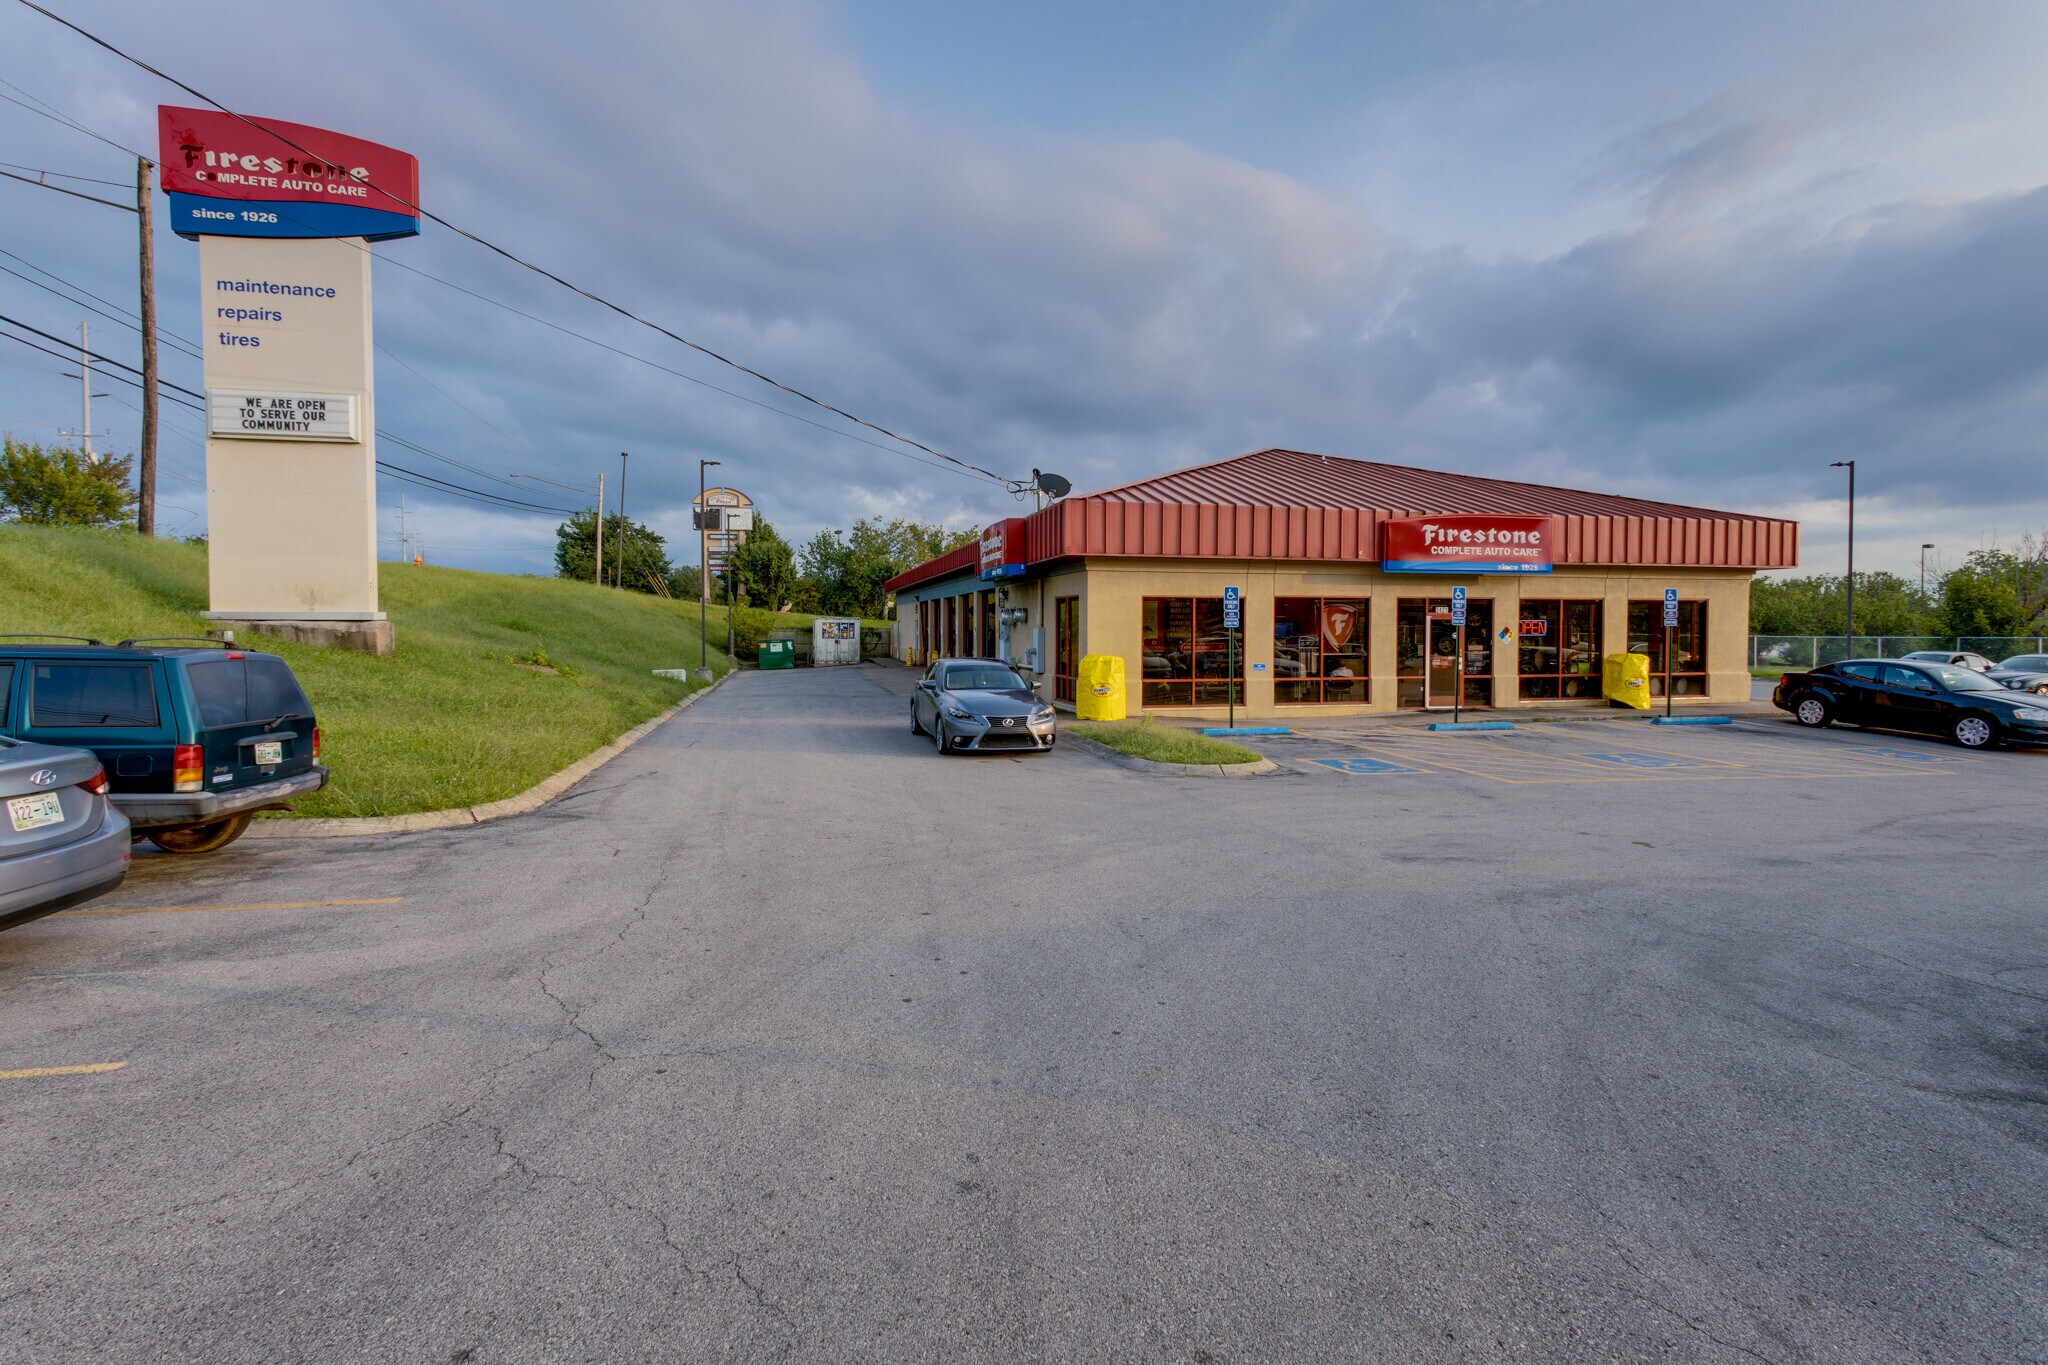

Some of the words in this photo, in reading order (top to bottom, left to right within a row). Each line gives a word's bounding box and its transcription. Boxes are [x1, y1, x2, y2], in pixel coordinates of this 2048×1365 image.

[180, 144, 369, 183] Firestone
[195, 170, 277, 188] COMPLETE
[281, 179, 323, 192] AUTO
[327, 184, 367, 198] CARE
[192, 208, 235, 221] since
[241, 211, 277, 224] 1926
[217, 279, 336, 298] maintenance
[217, 307, 282, 322] repairs
[219, 332, 260, 347] tires
[246, 398, 262, 407] WE
[270, 399, 292, 409] ARE
[297, 400, 326, 410] OPEN
[240, 408, 254, 418] TO
[261, 409, 295, 420] SERVE
[302, 411, 326, 421] OUR
[242, 419, 310, 431] COMMUNITY
[1421, 524, 1541, 546] Firestone
[1431, 546, 1482, 555] COMPLETE
[1485, 547, 1510, 556] AUTO
[1513, 548, 1539, 557] CARE
[13, 799, 61, 822] Y22-19U
